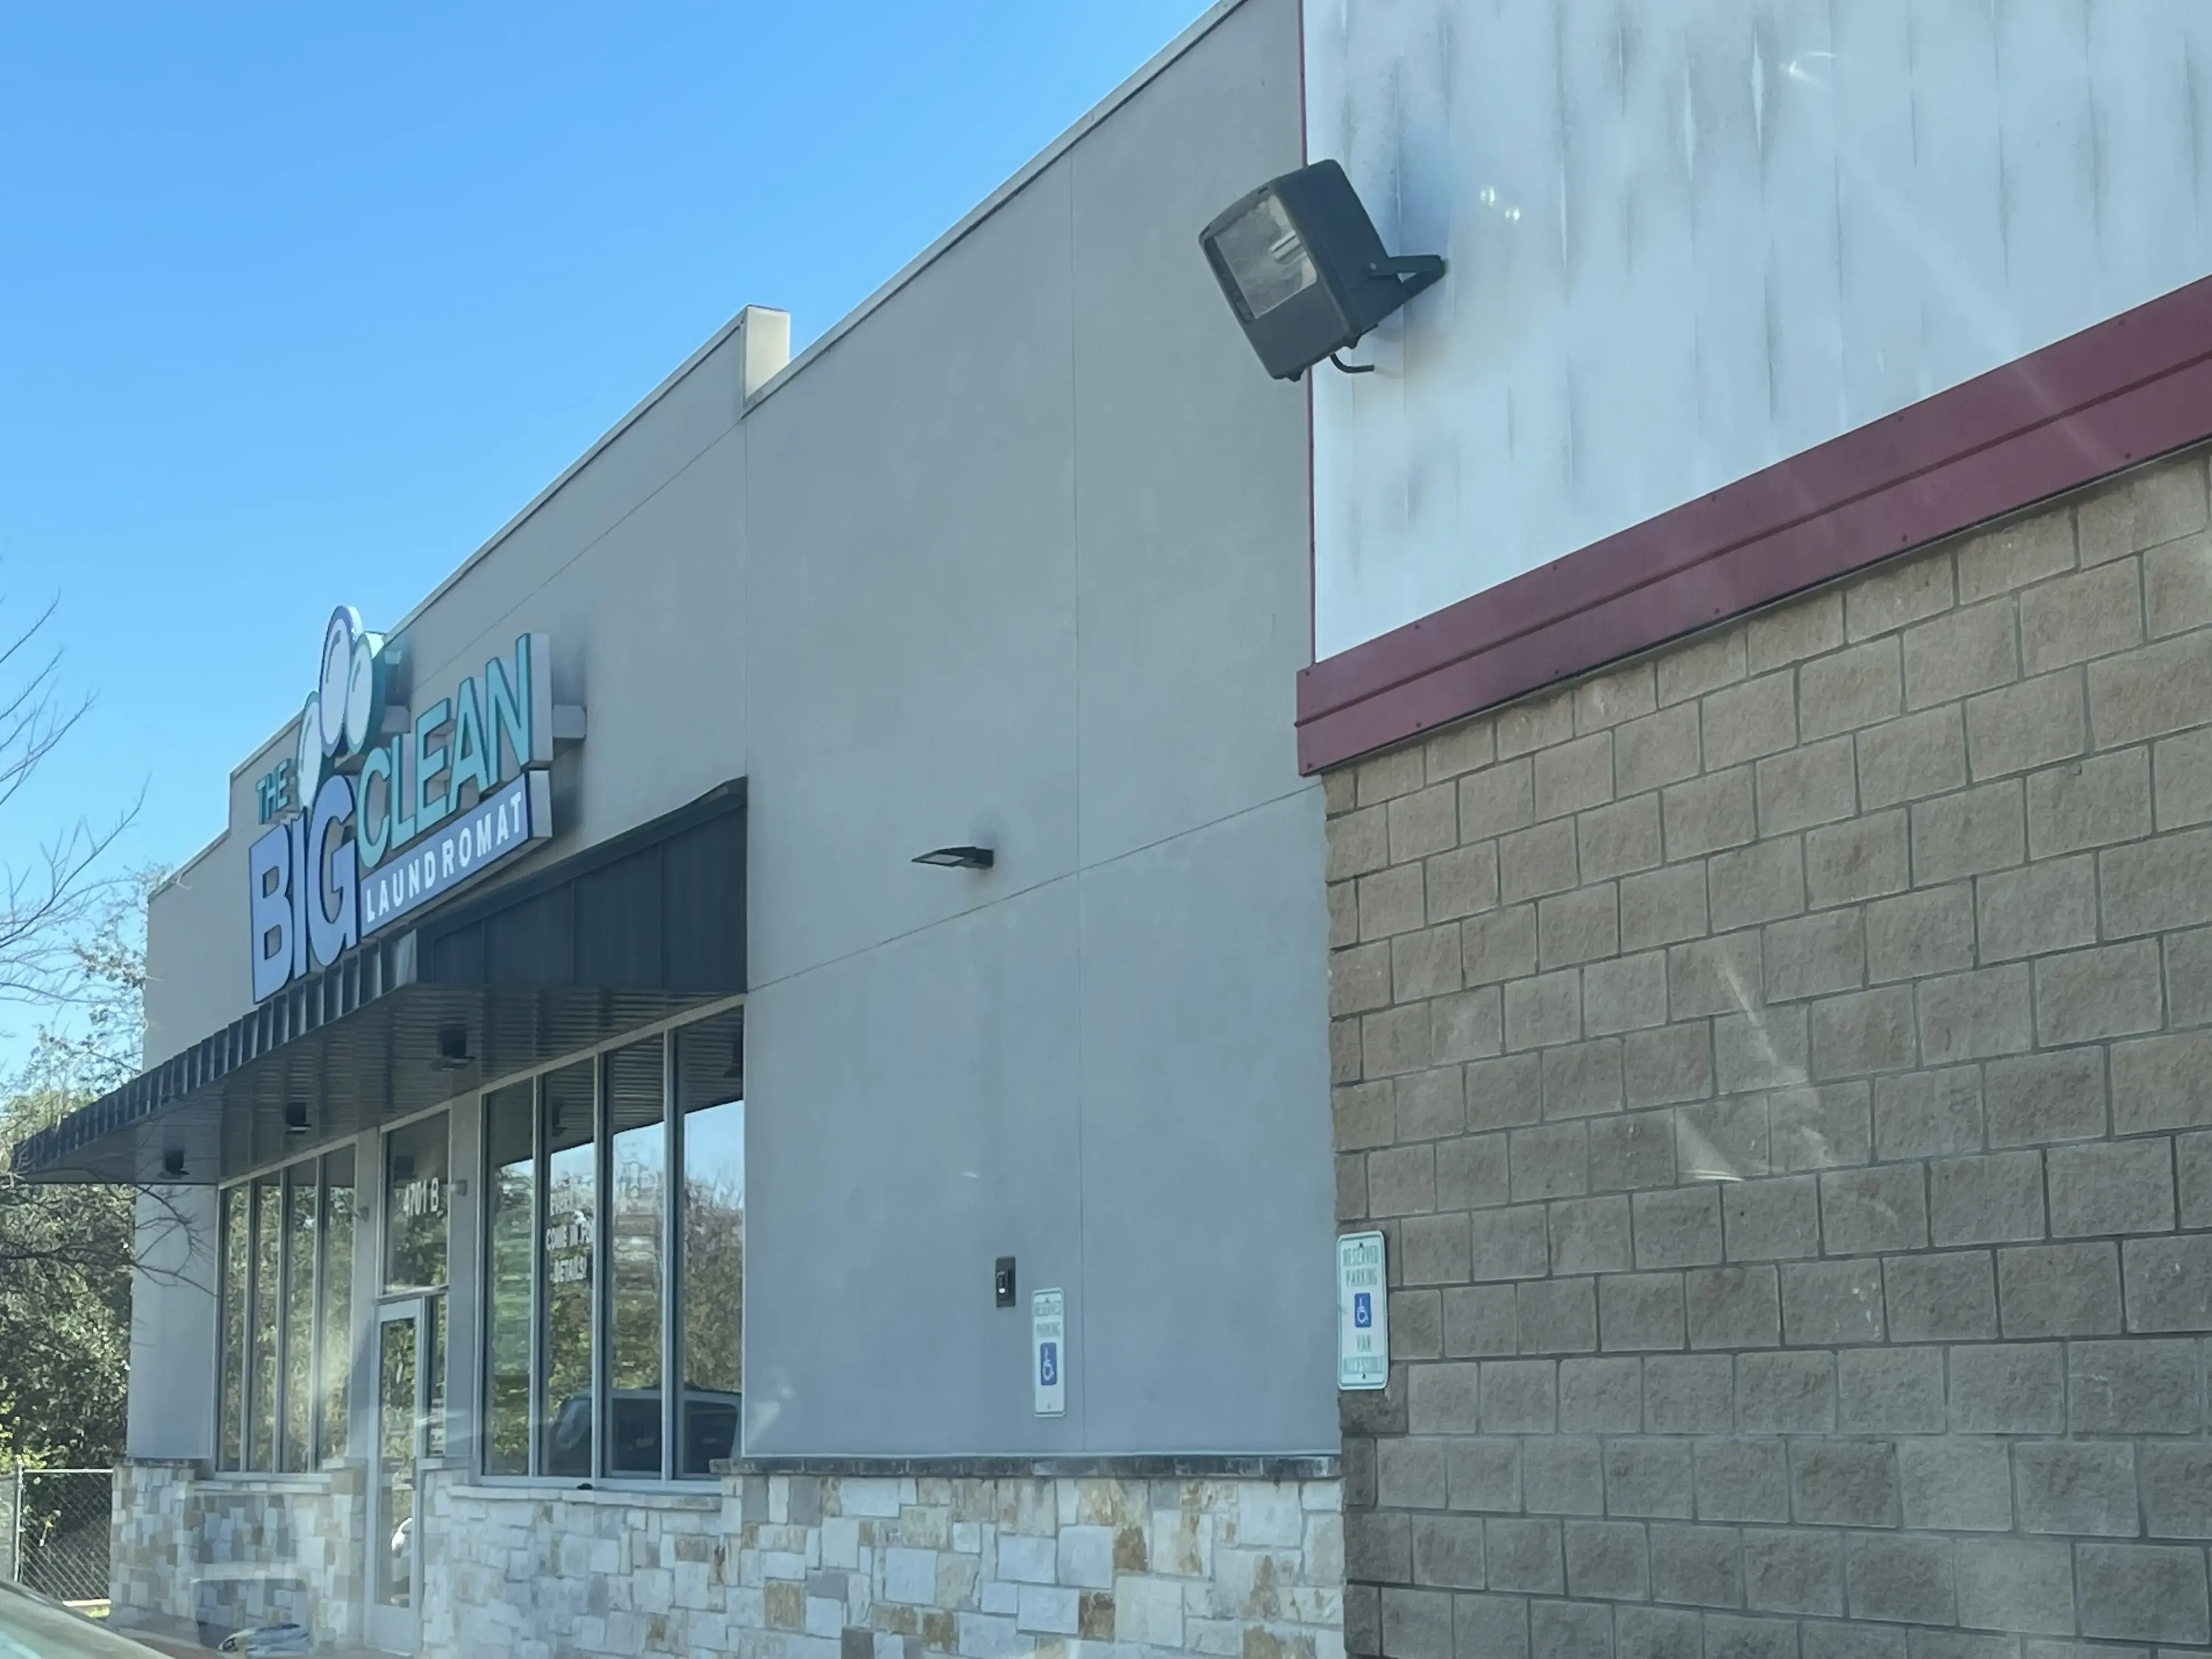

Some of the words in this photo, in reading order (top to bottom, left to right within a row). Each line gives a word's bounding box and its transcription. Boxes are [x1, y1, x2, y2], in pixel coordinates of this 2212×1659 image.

[256, 758, 295, 824] THE
[358, 633, 532, 868] CLEAN
[249, 774, 361, 1004] BIG
[365, 791, 523, 924] LAUNDROMAT
